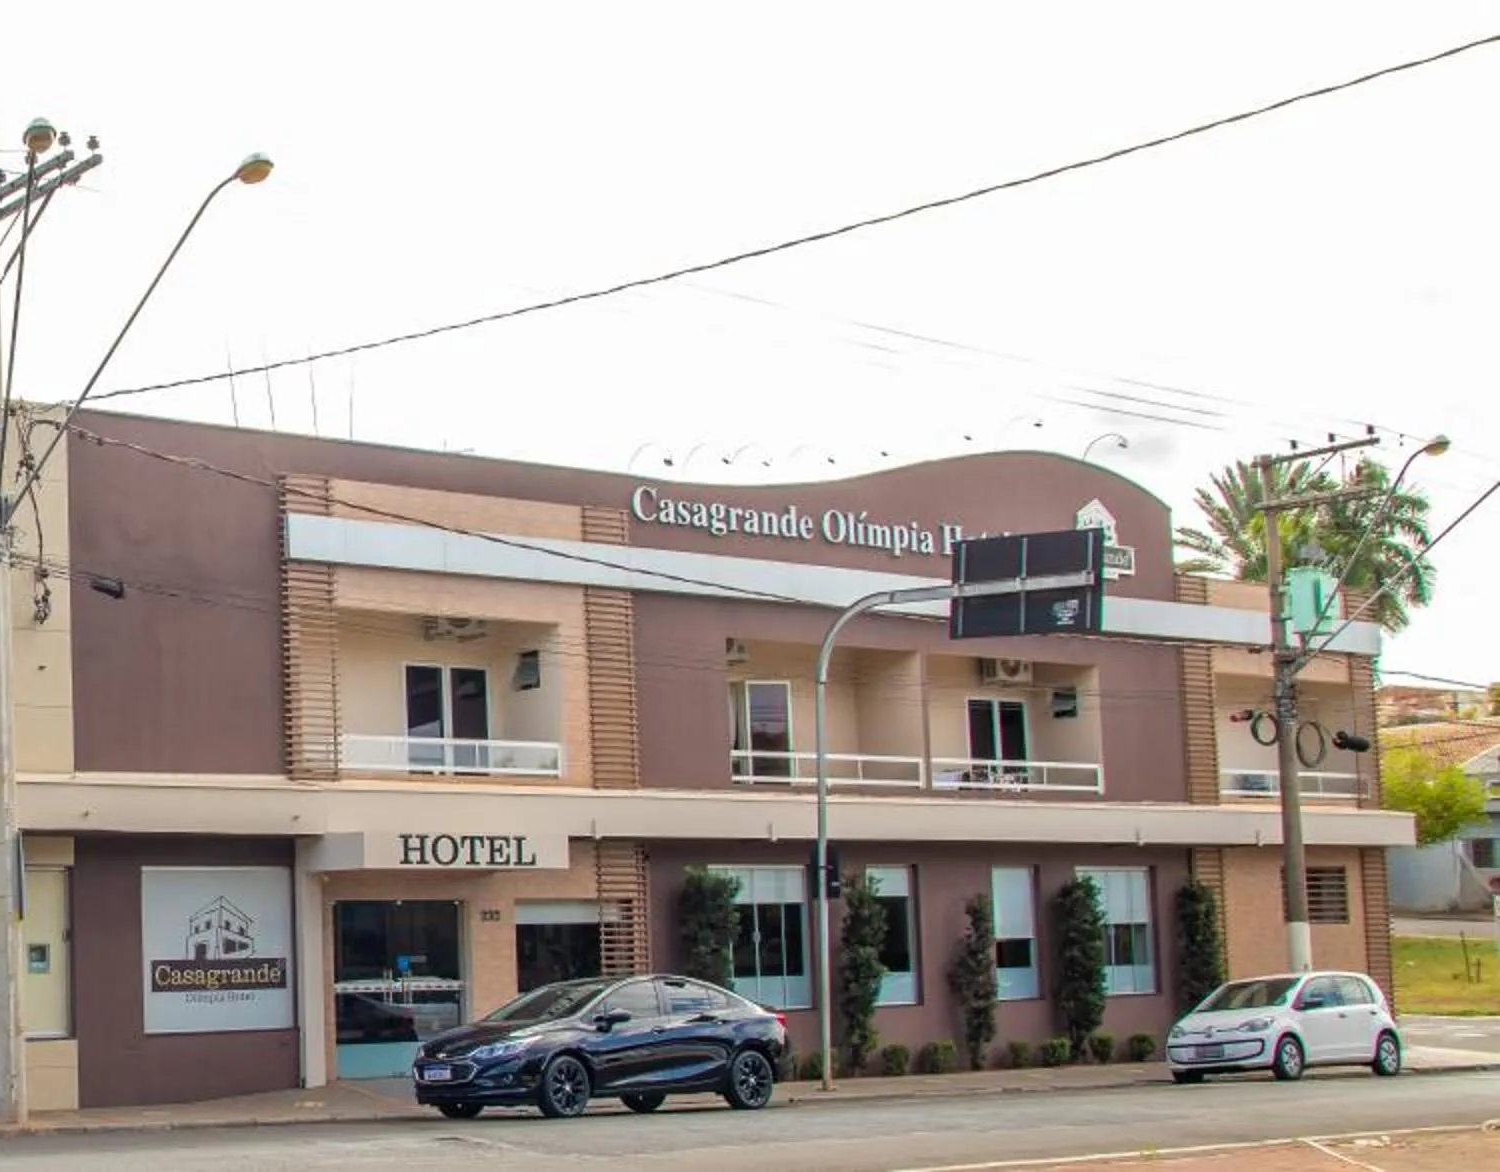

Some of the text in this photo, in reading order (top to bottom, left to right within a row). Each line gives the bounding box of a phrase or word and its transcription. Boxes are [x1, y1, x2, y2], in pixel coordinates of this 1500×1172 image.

[632, 484, 815, 540] Casagrande
[820, 508, 936, 557] Olímpia
[399, 834, 537, 866] HOTEL
[155, 964, 282, 988] Casagrande
